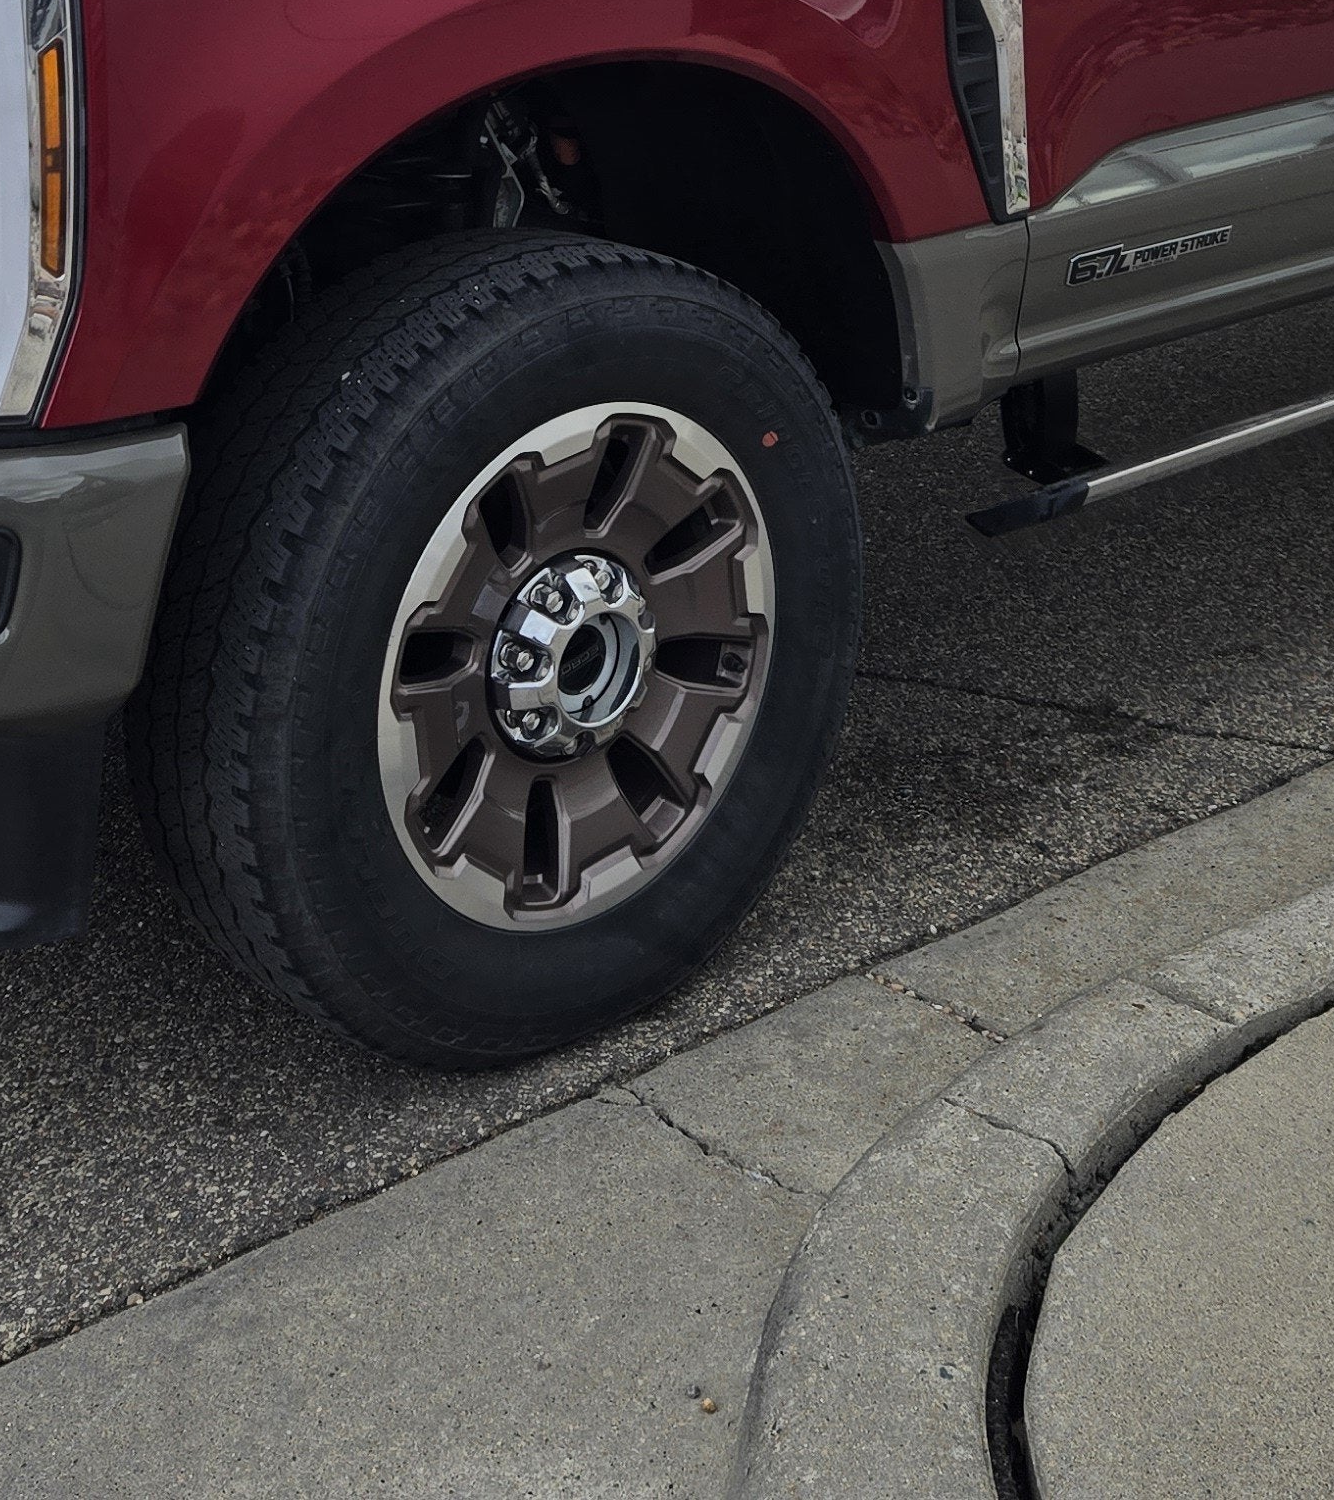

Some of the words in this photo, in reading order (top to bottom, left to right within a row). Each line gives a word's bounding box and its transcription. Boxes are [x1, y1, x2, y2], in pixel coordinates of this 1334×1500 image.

[1068, 247, 1132, 285] 6.7L
[1132, 241, 1178, 265] POWER
[1179, 229, 1230, 253] STROKE
